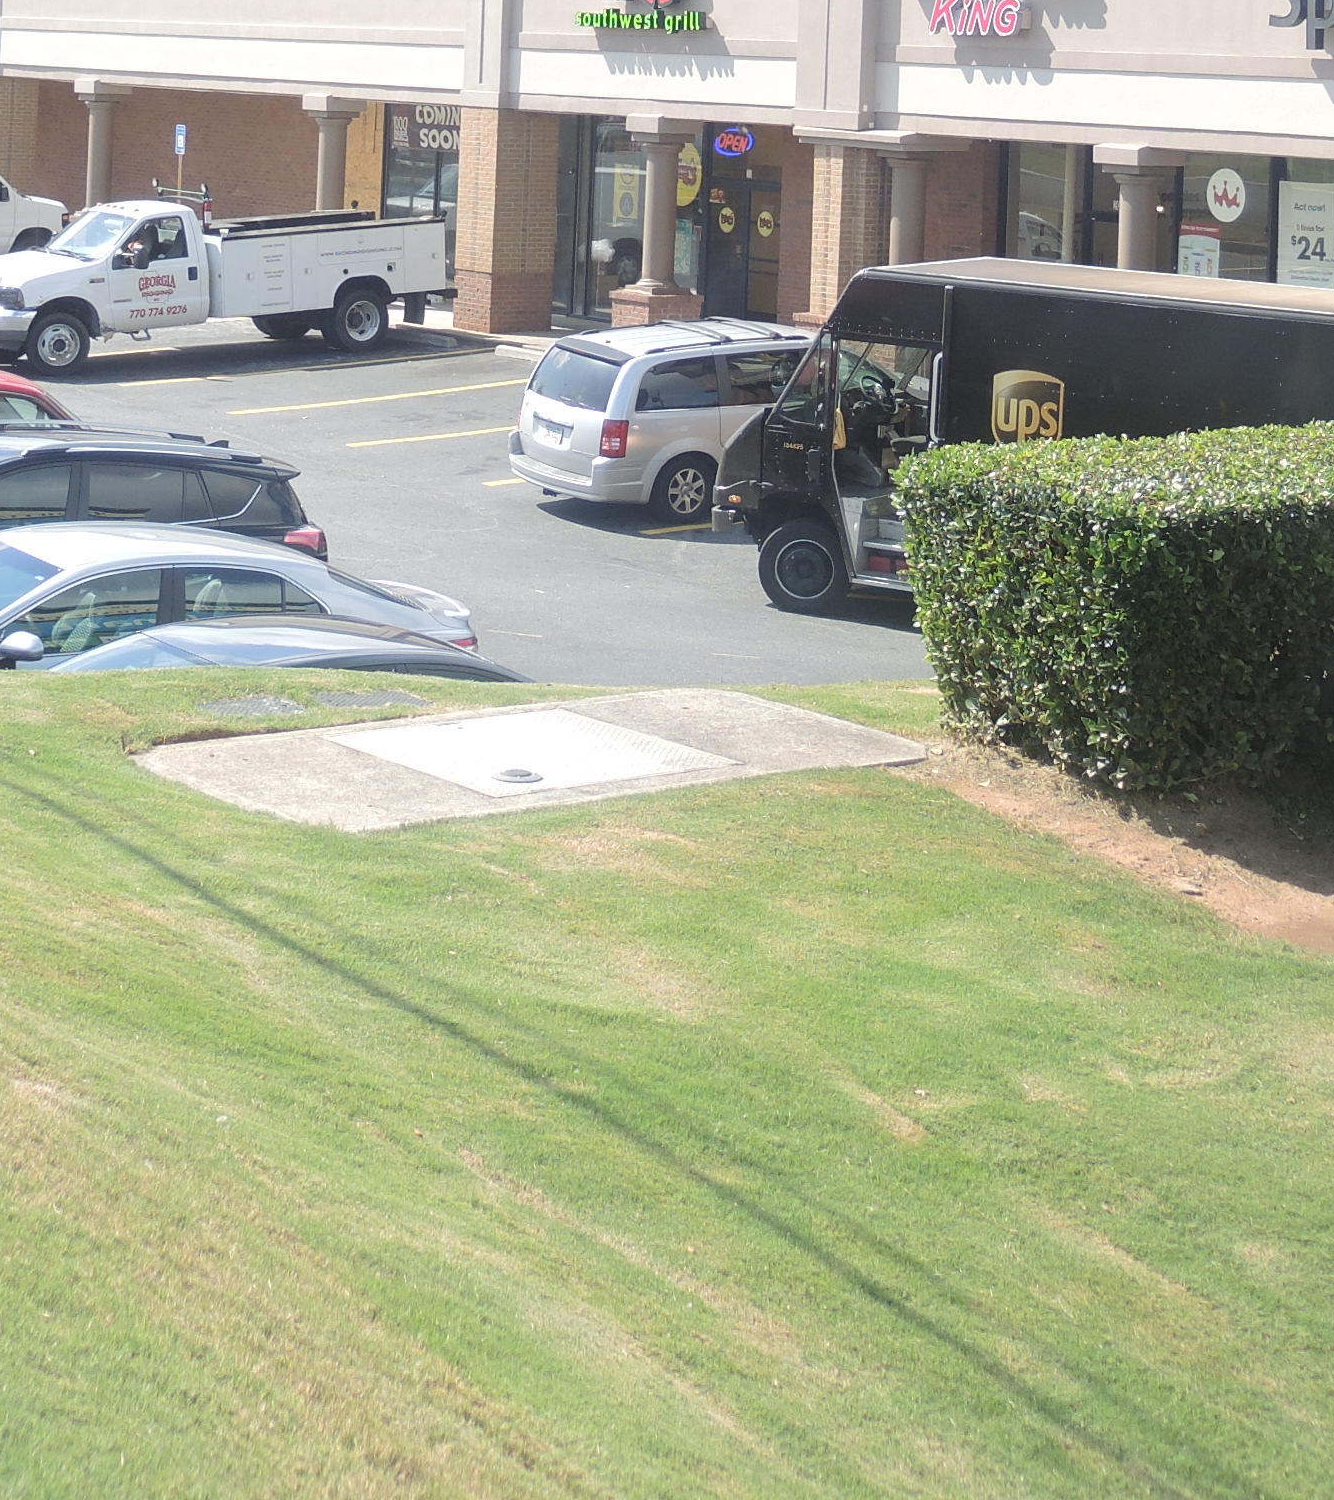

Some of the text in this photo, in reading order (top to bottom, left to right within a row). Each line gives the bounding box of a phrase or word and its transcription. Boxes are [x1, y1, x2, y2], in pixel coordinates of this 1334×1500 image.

[574, 8, 701, 35] southwest grill
[415, 104, 461, 126] COMIN
[419, 127, 460, 150] SOON
[717, 132, 749, 153] OPEN
[1294, 202, 1307, 212] Act
[1290, 234, 1327, 262] $24
[138, 274, 177, 292] GEORGIA
[129, 309, 146, 319] 770
[148, 307, 164, 318] 774
[996, 396, 1059, 441] ups
